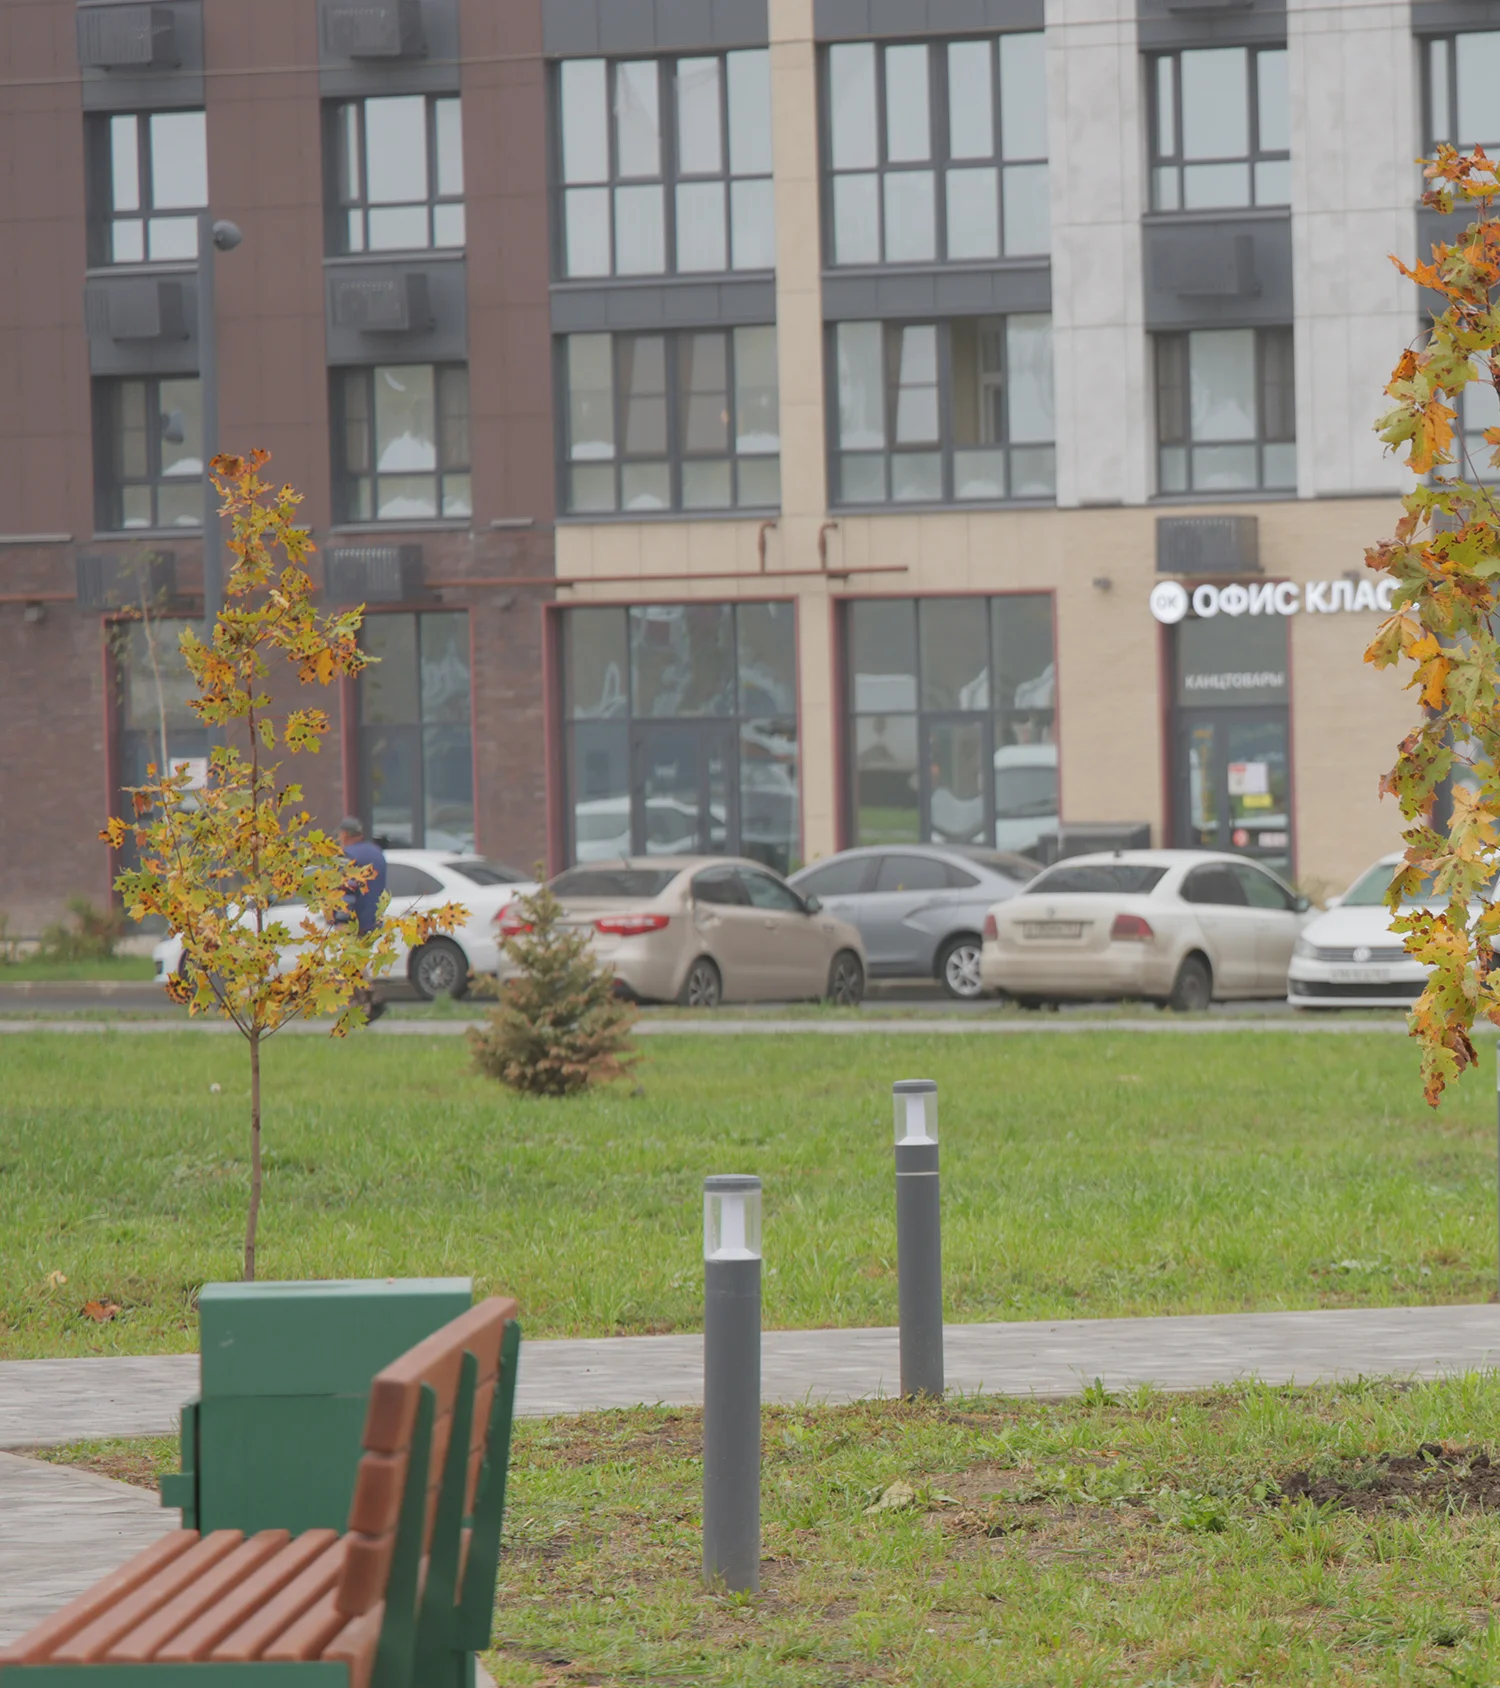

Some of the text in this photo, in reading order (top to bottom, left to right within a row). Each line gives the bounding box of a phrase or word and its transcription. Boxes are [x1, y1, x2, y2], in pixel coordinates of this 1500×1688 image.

[1192, 582, 1300, 617] ОФИС
[1305, 579, 1420, 613] КЛАС
[1185, 671, 1284, 690] КАНЦТОВАРЫ
